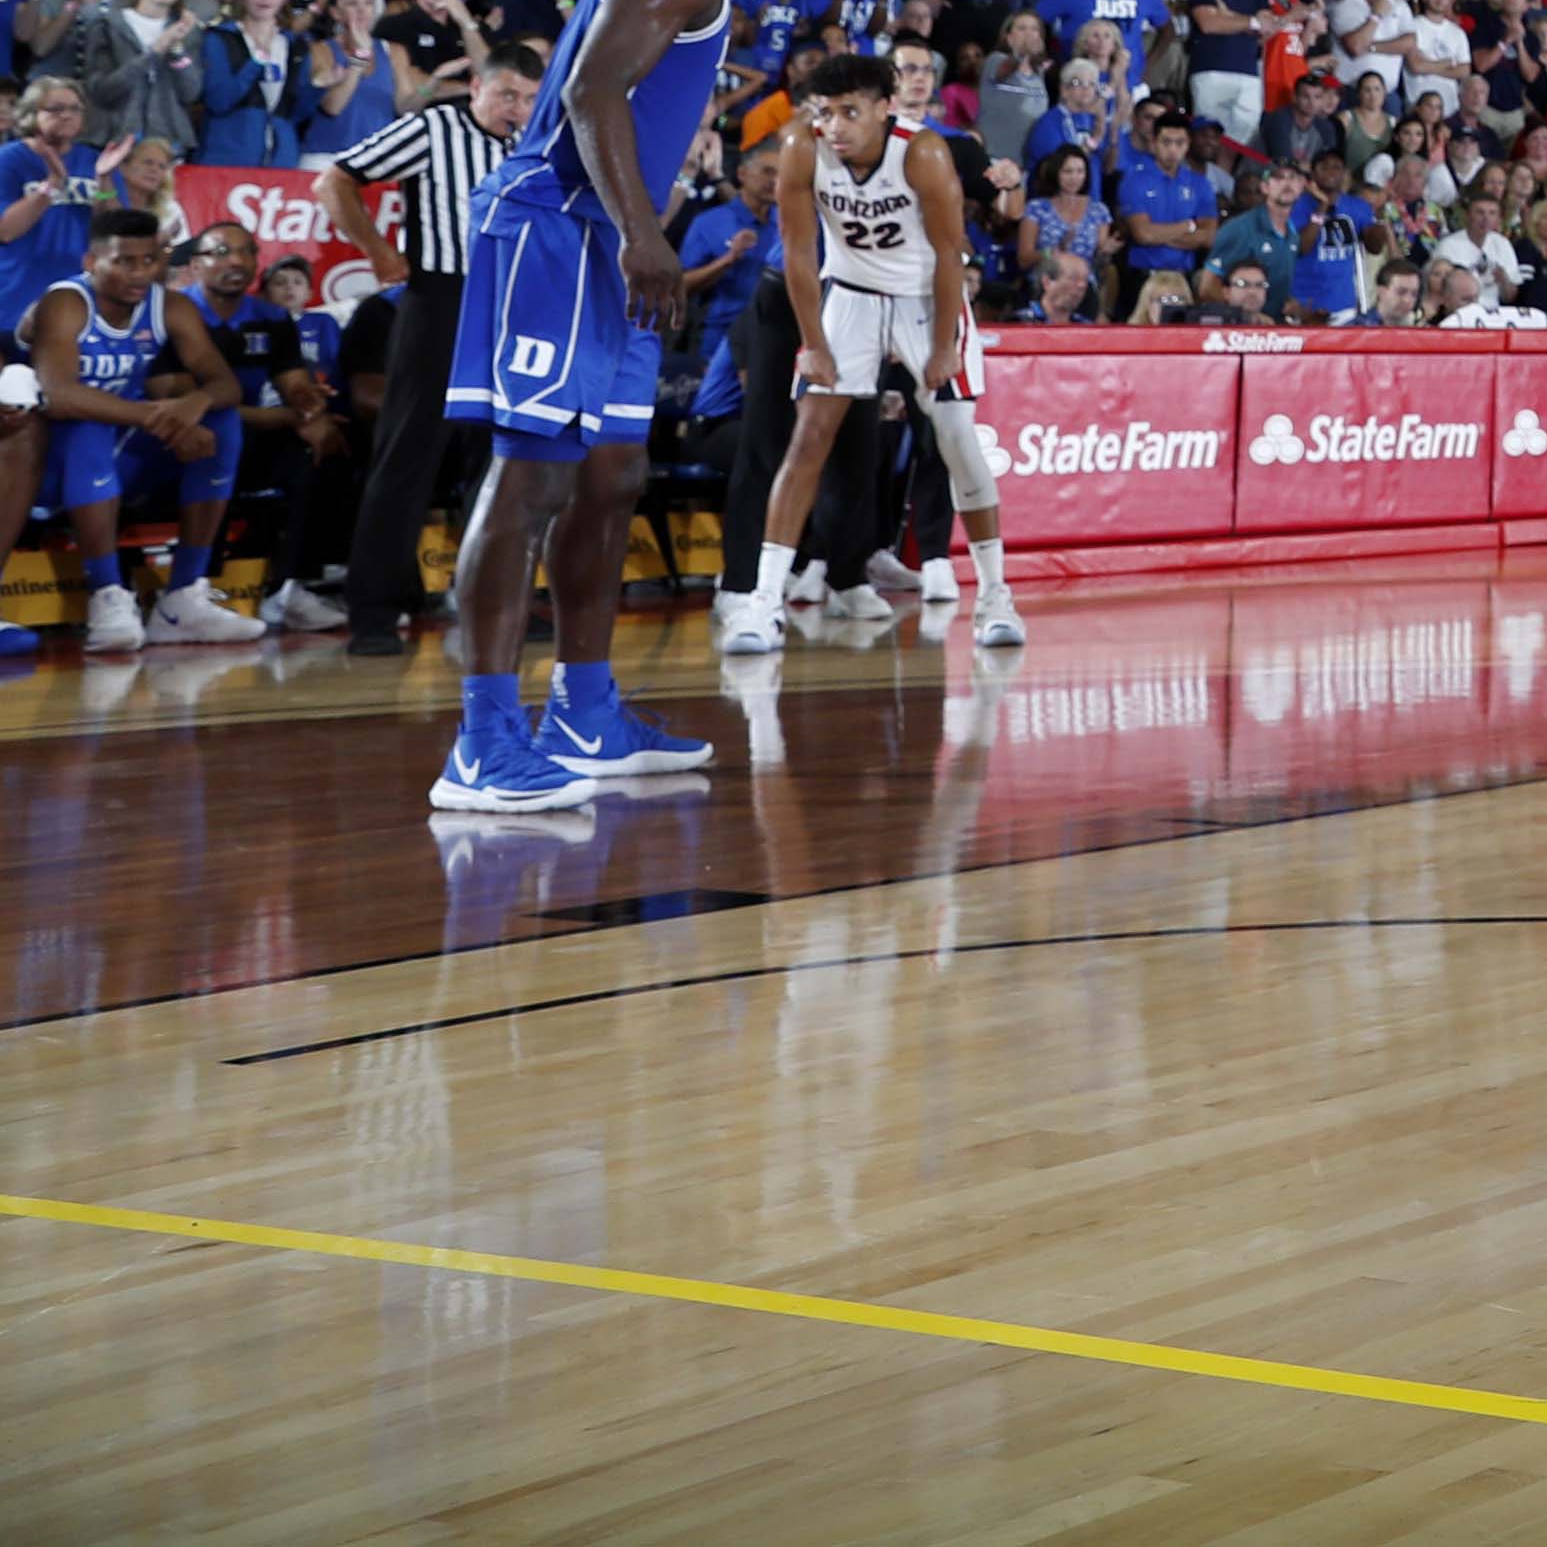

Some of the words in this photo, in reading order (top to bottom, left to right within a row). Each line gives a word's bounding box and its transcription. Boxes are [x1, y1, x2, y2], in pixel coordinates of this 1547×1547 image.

[771, 29, 785, 52] 5
[818, 190, 912, 220] GONZAGA
[842, 221, 906, 250] 22
[508, 334, 556, 379] D
